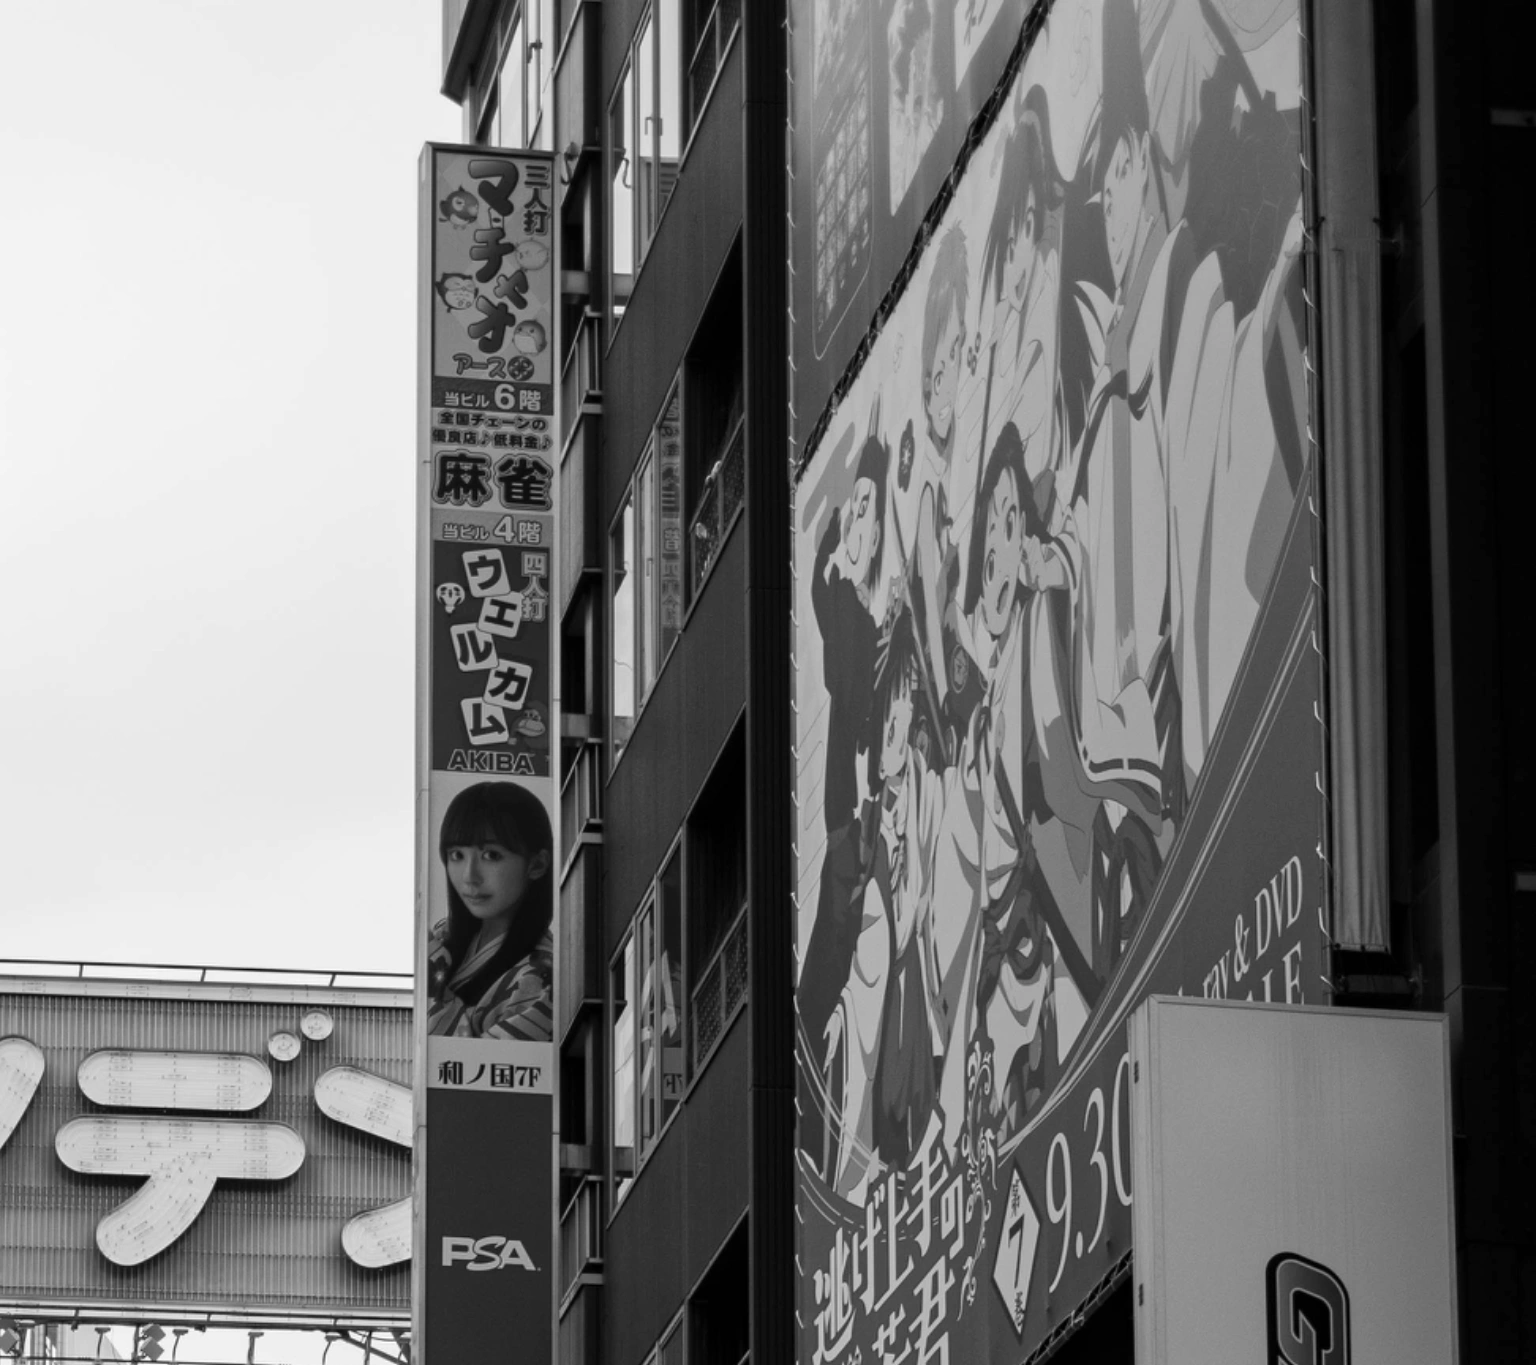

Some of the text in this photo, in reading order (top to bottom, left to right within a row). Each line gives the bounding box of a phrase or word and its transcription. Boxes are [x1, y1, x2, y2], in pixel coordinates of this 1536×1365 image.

[524, 164, 548, 236] 三人打
[452, 353, 507, 378] アース
[433, 450, 553, 511] 麻雀
[448, 749, 535, 774] AKIBA
[1255, 855, 1303, 960] DVD
[441, 1235, 541, 1272] PSA
